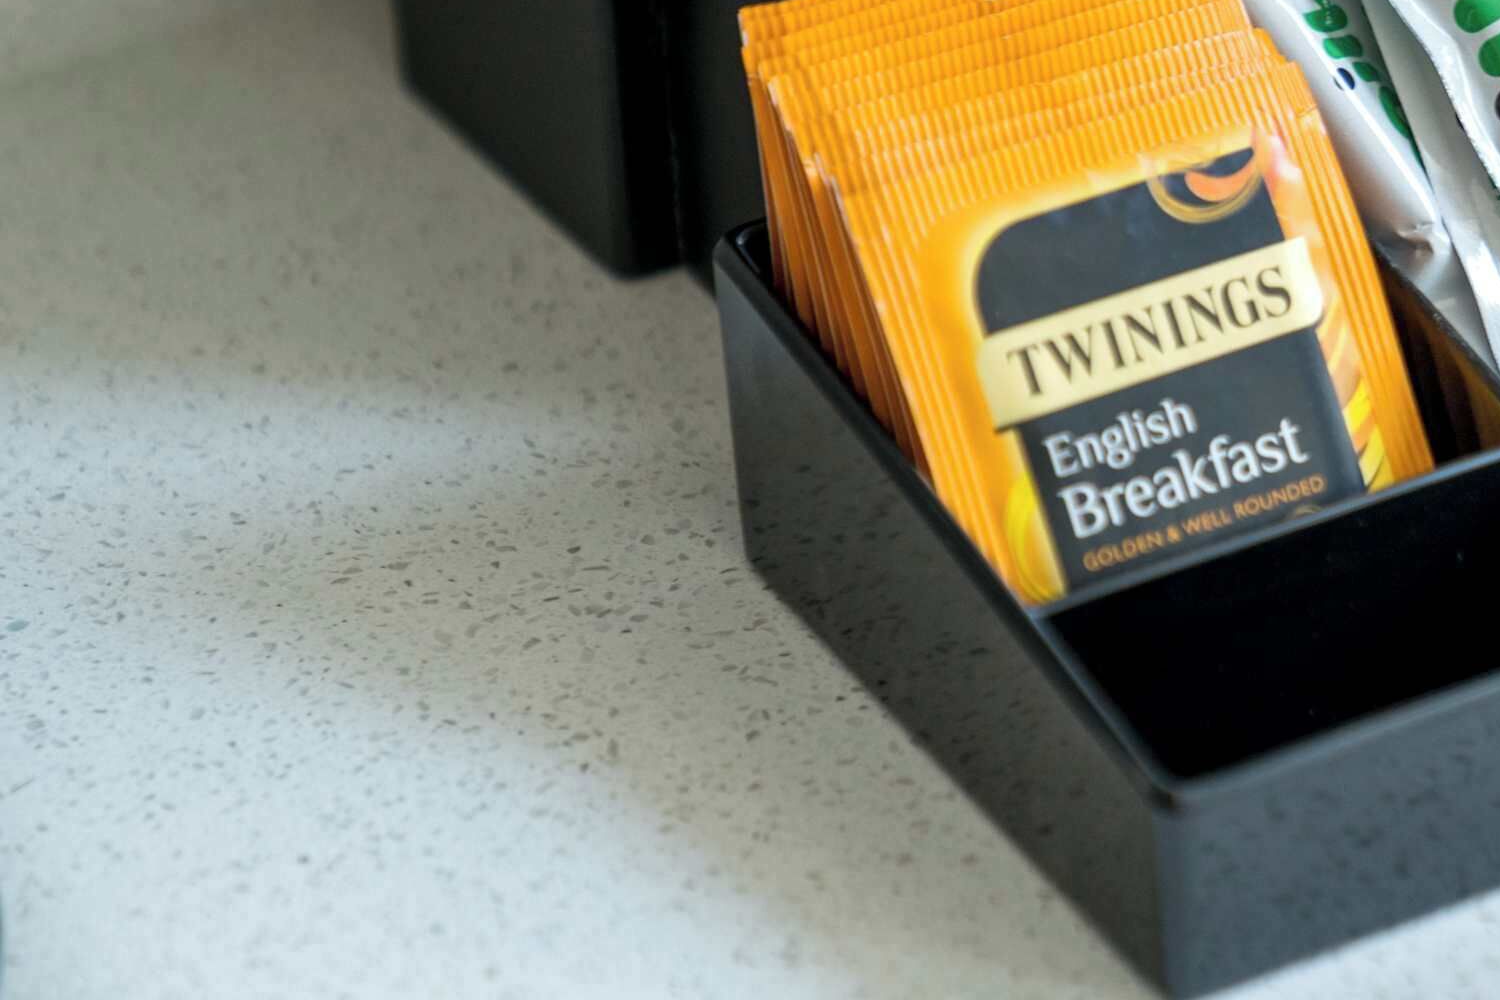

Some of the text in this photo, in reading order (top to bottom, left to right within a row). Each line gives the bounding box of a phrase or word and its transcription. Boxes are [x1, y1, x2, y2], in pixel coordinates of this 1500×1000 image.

[1005, 265, 1294, 396] TWININGS
[1042, 397, 1198, 479] English
[1058, 416, 1311, 540] Breakfast
[1081, 473, 1328, 572] GOLDEN & WELL ROUNDED
